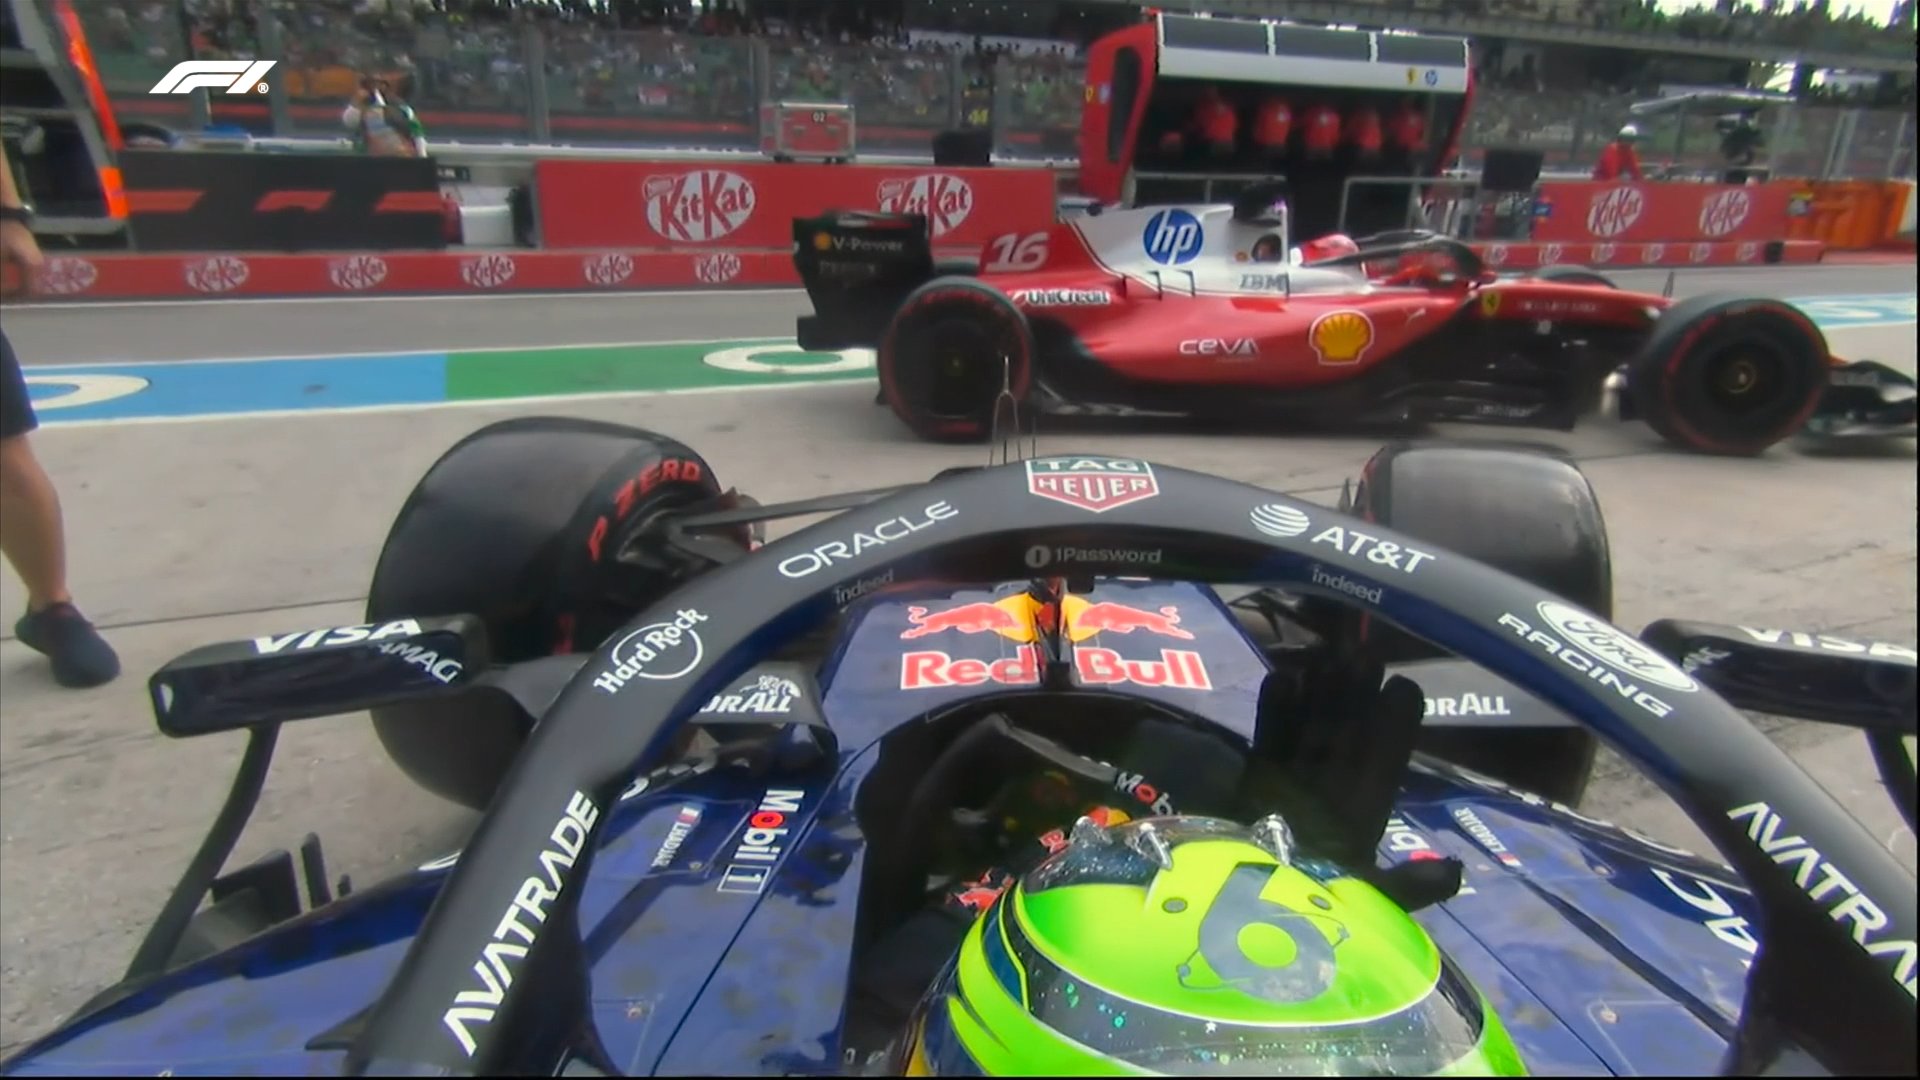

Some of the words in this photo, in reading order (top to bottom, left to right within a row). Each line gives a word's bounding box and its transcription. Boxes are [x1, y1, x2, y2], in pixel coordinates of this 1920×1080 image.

[659, 172, 750, 240] KitKat
[1591, 188, 1643, 236] KitKat
[1703, 191, 1748, 236] KitKat
[984, 232, 1049, 273] 16
[1154, 209, 1198, 265] hp
[1027, 289, 1110, 305] UniCredit
[1239, 273, 1287, 291] IBM
[1038, 476, 1150, 502] HEUER
[1040, 459, 1141, 472] TAG
[778, 500, 958, 578] ORACLE
[1056, 547, 1162, 565] 1Password
[1310, 525, 1436, 574] AT&T
[835, 570, 895, 605] indeed
[1311, 567, 1383, 605] indeed
[253, 617, 423, 655] VISA
[593, 641, 657, 695] Hard
[643, 606, 709, 648] Rock
[1562, 619, 1667, 672] Ford
[901, 643, 1041, 690] Red
[1073, 645, 1213, 690] Bull
[1497, 612, 1675, 719] RACING
[733, 789, 805, 861] Mobil
[443, 790, 599, 1057] AVATRADE
[1726, 801, 1917, 1001] AVATRA
[1199, 861, 1337, 1005] 6
